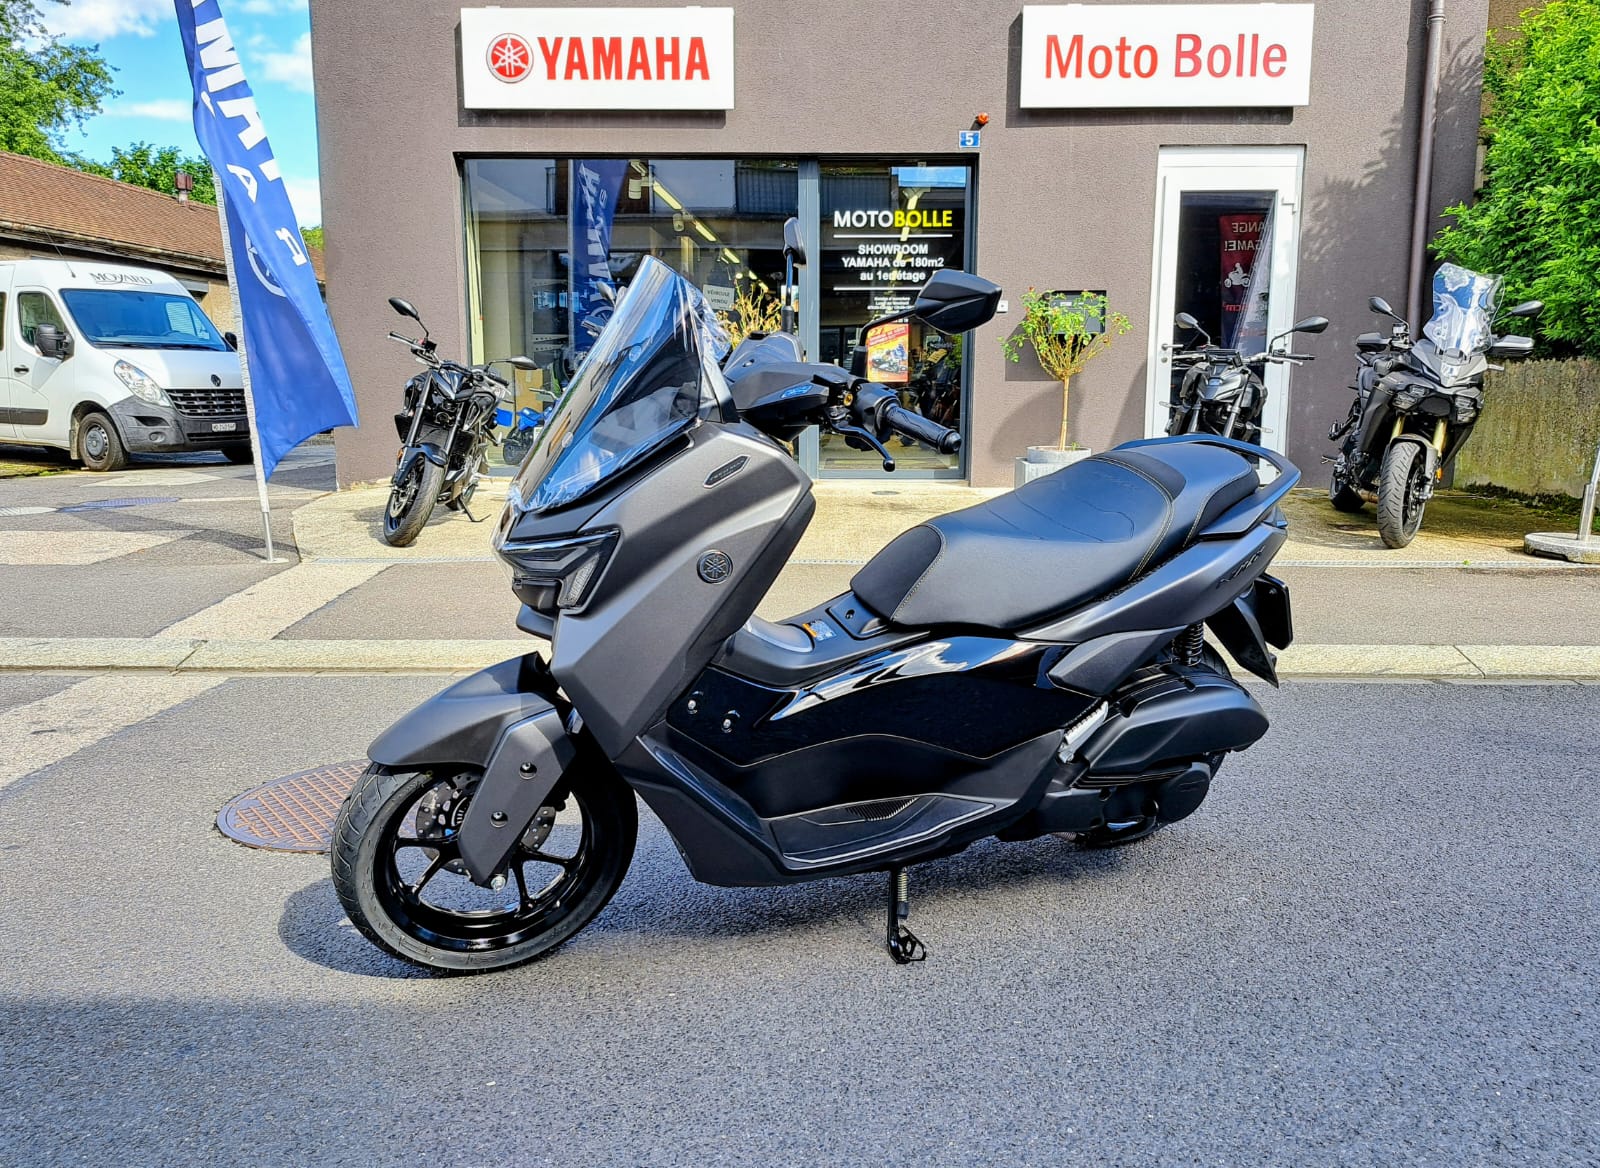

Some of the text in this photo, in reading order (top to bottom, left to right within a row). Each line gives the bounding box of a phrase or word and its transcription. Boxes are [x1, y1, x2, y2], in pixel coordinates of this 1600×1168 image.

[537, 36, 710, 81] YAMAHA
[1045, 33, 1287, 79] Moto Bolle
[965, 132, 974, 146] 5
[833, 210, 953, 228] MOTOBOLLE
[858, 244, 929, 255] SHOWROOM
[842, 257, 945, 268] YAMAHA de 180m2
[860, 272, 874, 281] au
[896, 270, 926, 283] étage
